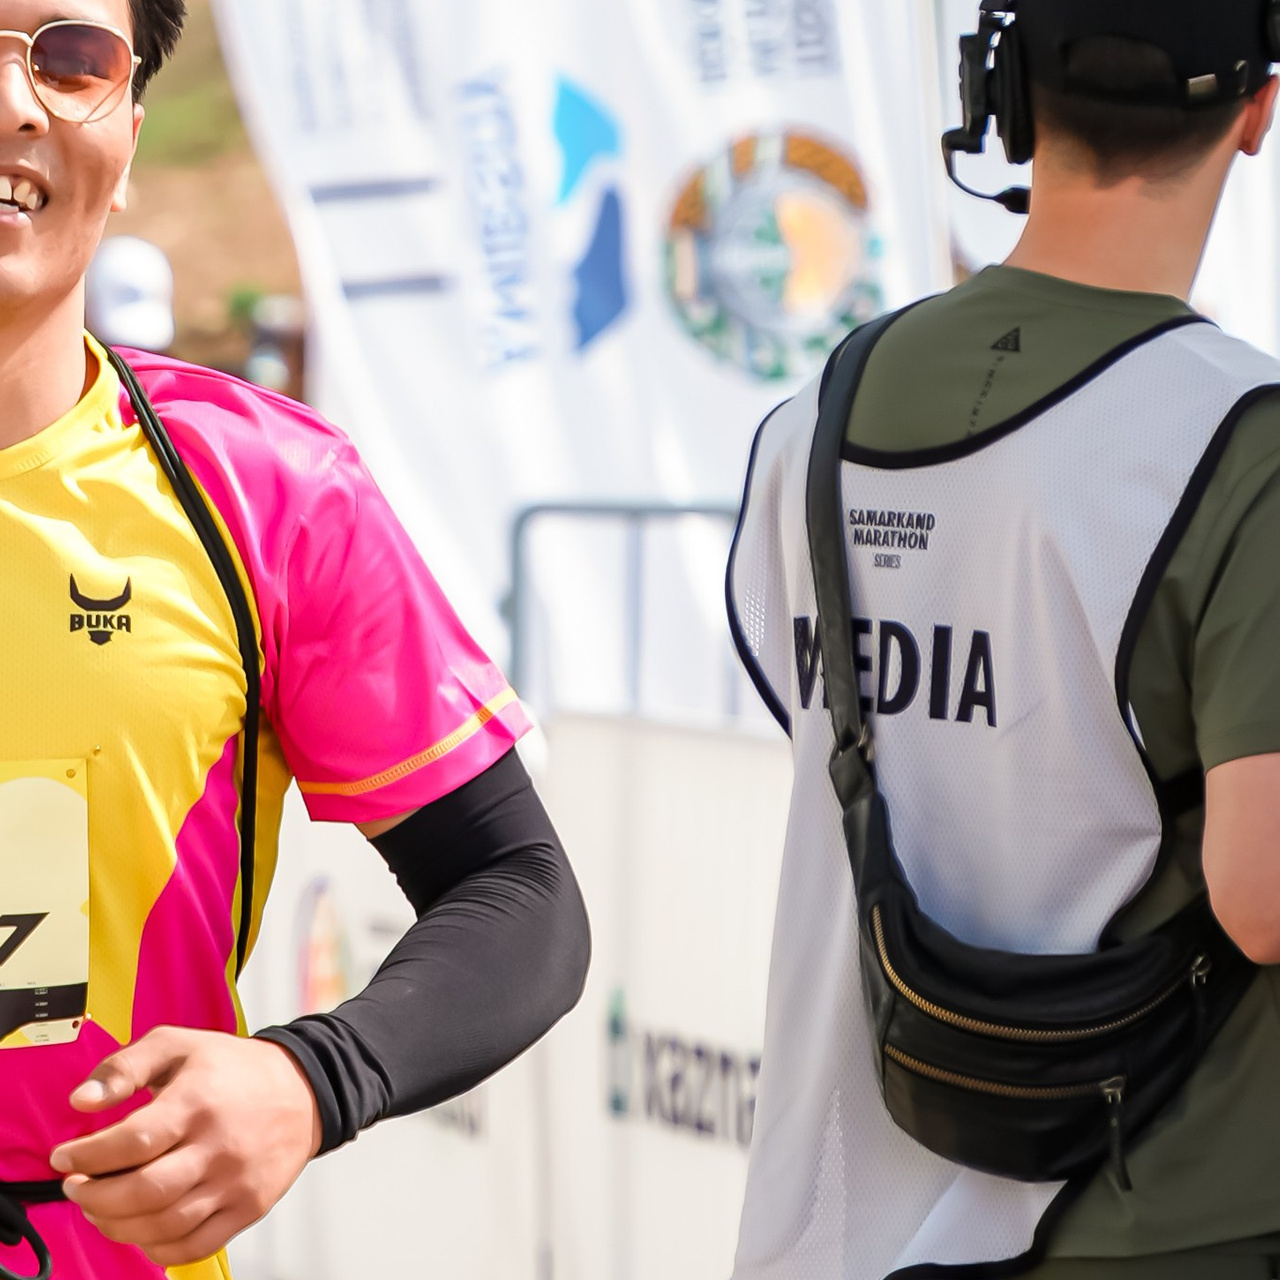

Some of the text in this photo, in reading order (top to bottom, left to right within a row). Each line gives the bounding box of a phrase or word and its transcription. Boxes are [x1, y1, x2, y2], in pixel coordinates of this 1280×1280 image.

[849, 508, 936, 531] SAMARKAND
[853, 528, 929, 550] MARATHON
[874, 553, 901, 569] SERIES
[69, 614, 131, 633] BUKA
[793, 615, 998, 728] MEDIA
